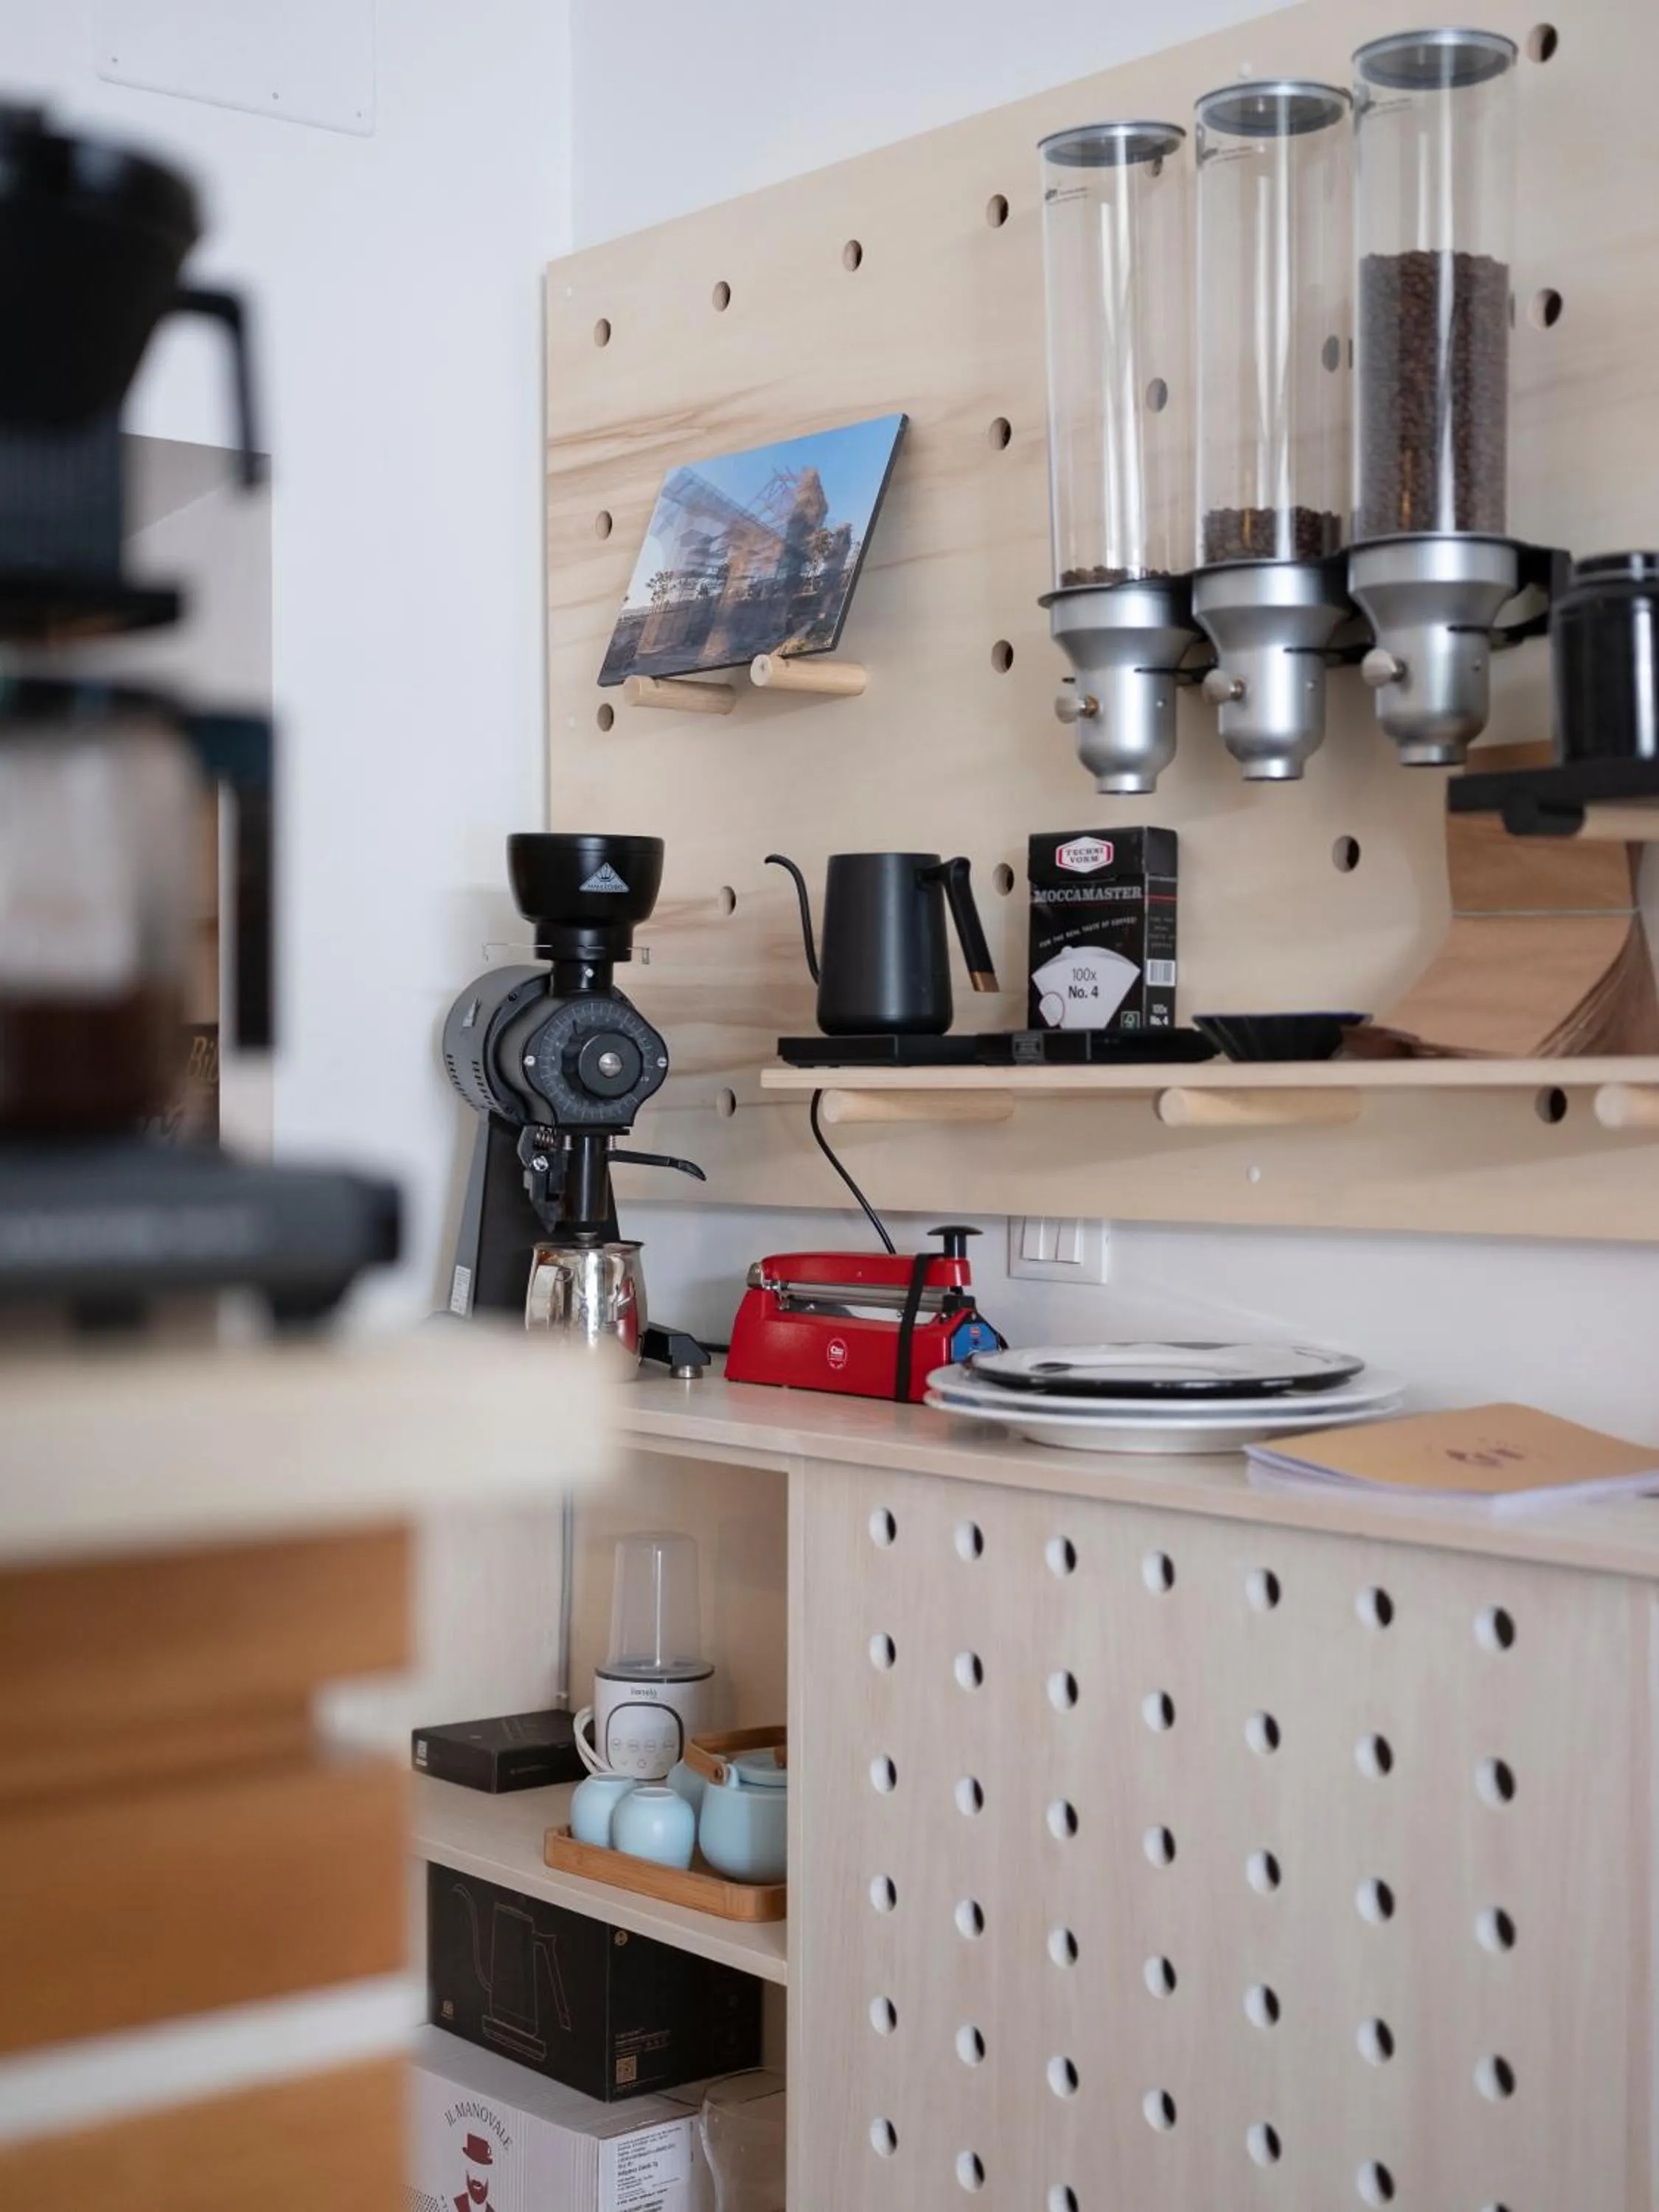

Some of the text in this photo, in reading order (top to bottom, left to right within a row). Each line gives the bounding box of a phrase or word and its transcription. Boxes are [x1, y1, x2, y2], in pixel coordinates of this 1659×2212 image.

[1066, 847, 1104, 855] TECHNI
[1070, 855, 1099, 863] VORM
[1034, 886, 1142, 903] MOCCAMASTER
[1082, 922, 1100, 932] TASTE
[1072, 967, 1097, 982] 100x
[1068, 985, 1099, 999] No. 4
[455, 2101, 514, 2151] MANOVALE
